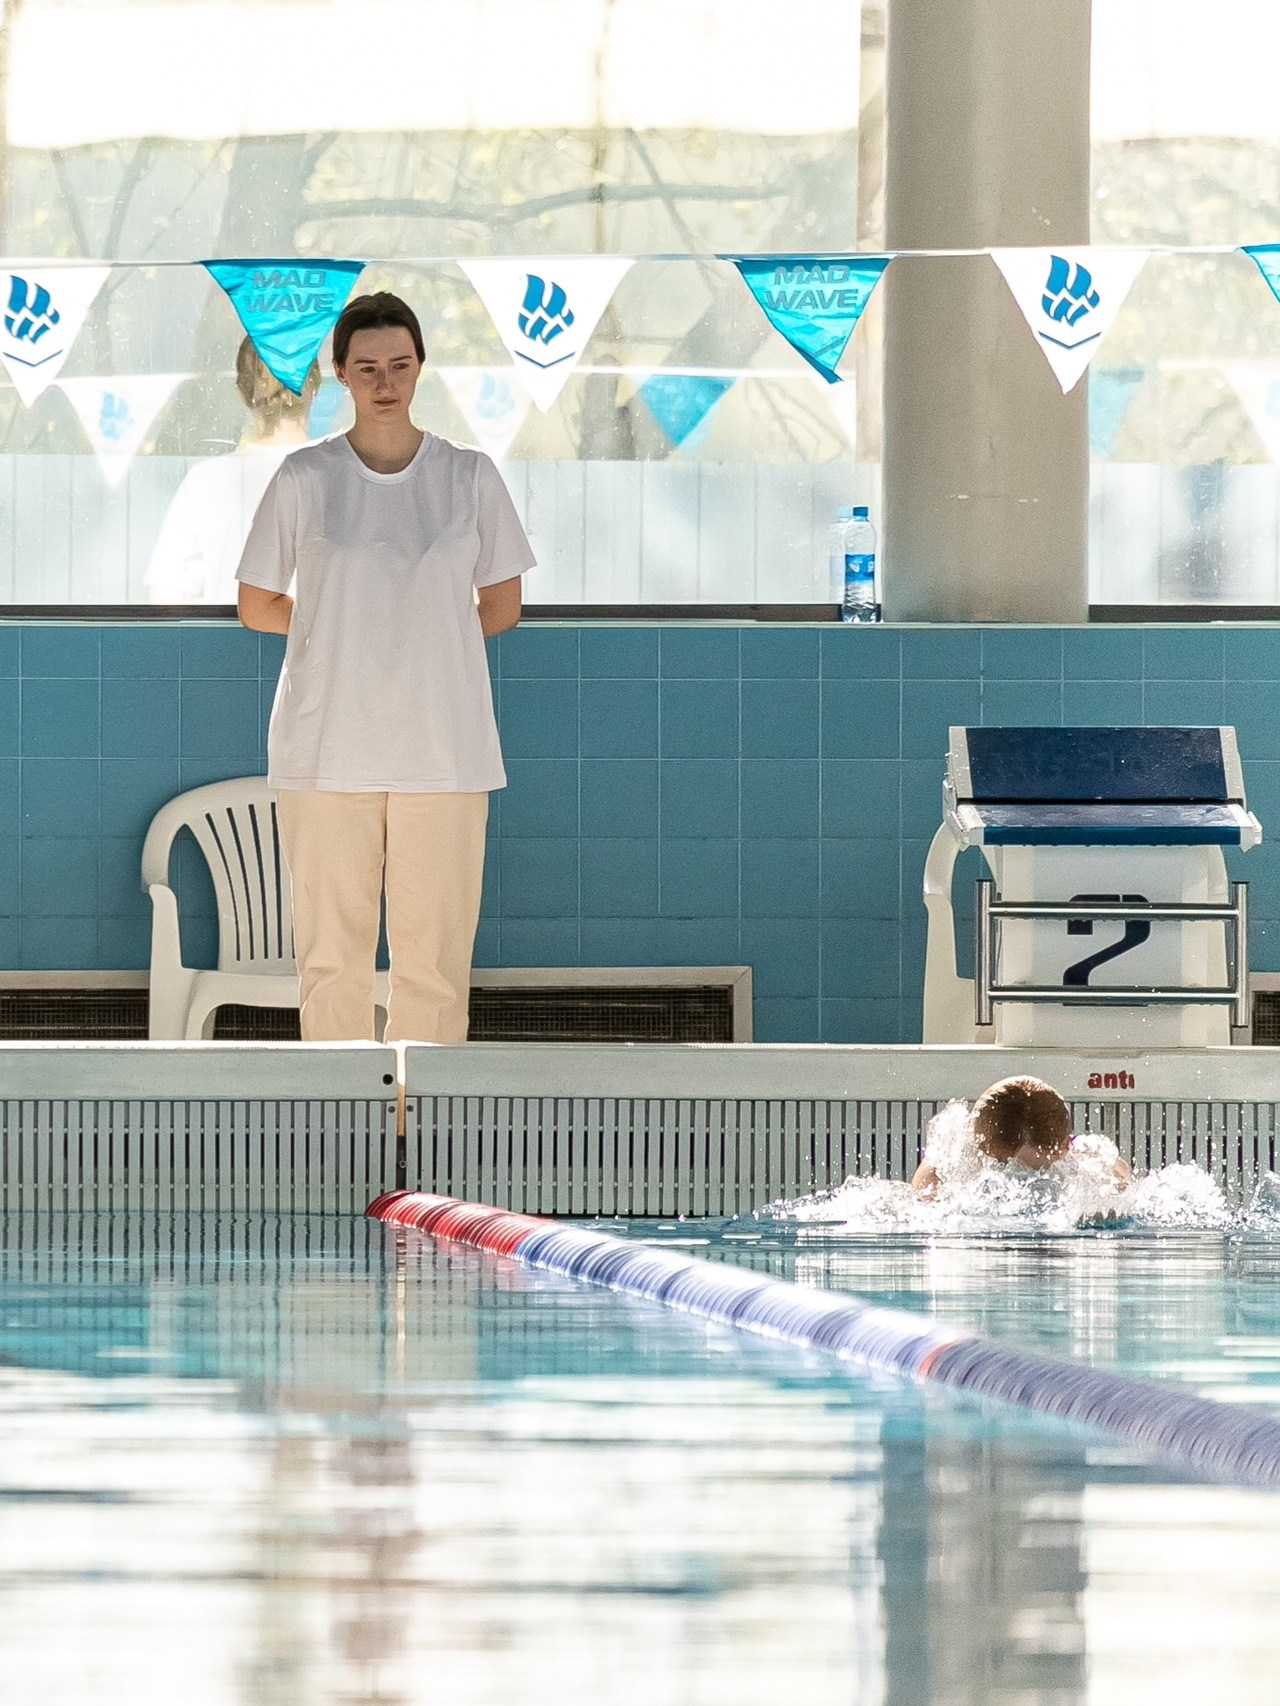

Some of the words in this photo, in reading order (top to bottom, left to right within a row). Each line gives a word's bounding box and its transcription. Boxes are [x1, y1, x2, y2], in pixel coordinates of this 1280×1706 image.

[253, 269, 326, 288] MAD
[774, 265, 849, 285] MAD
[243, 293, 334, 312] WAVE
[765, 289, 858, 310] WAVE
[1063, 894, 1151, 1007] 2
[1087, 1070, 1135, 1089] anti
